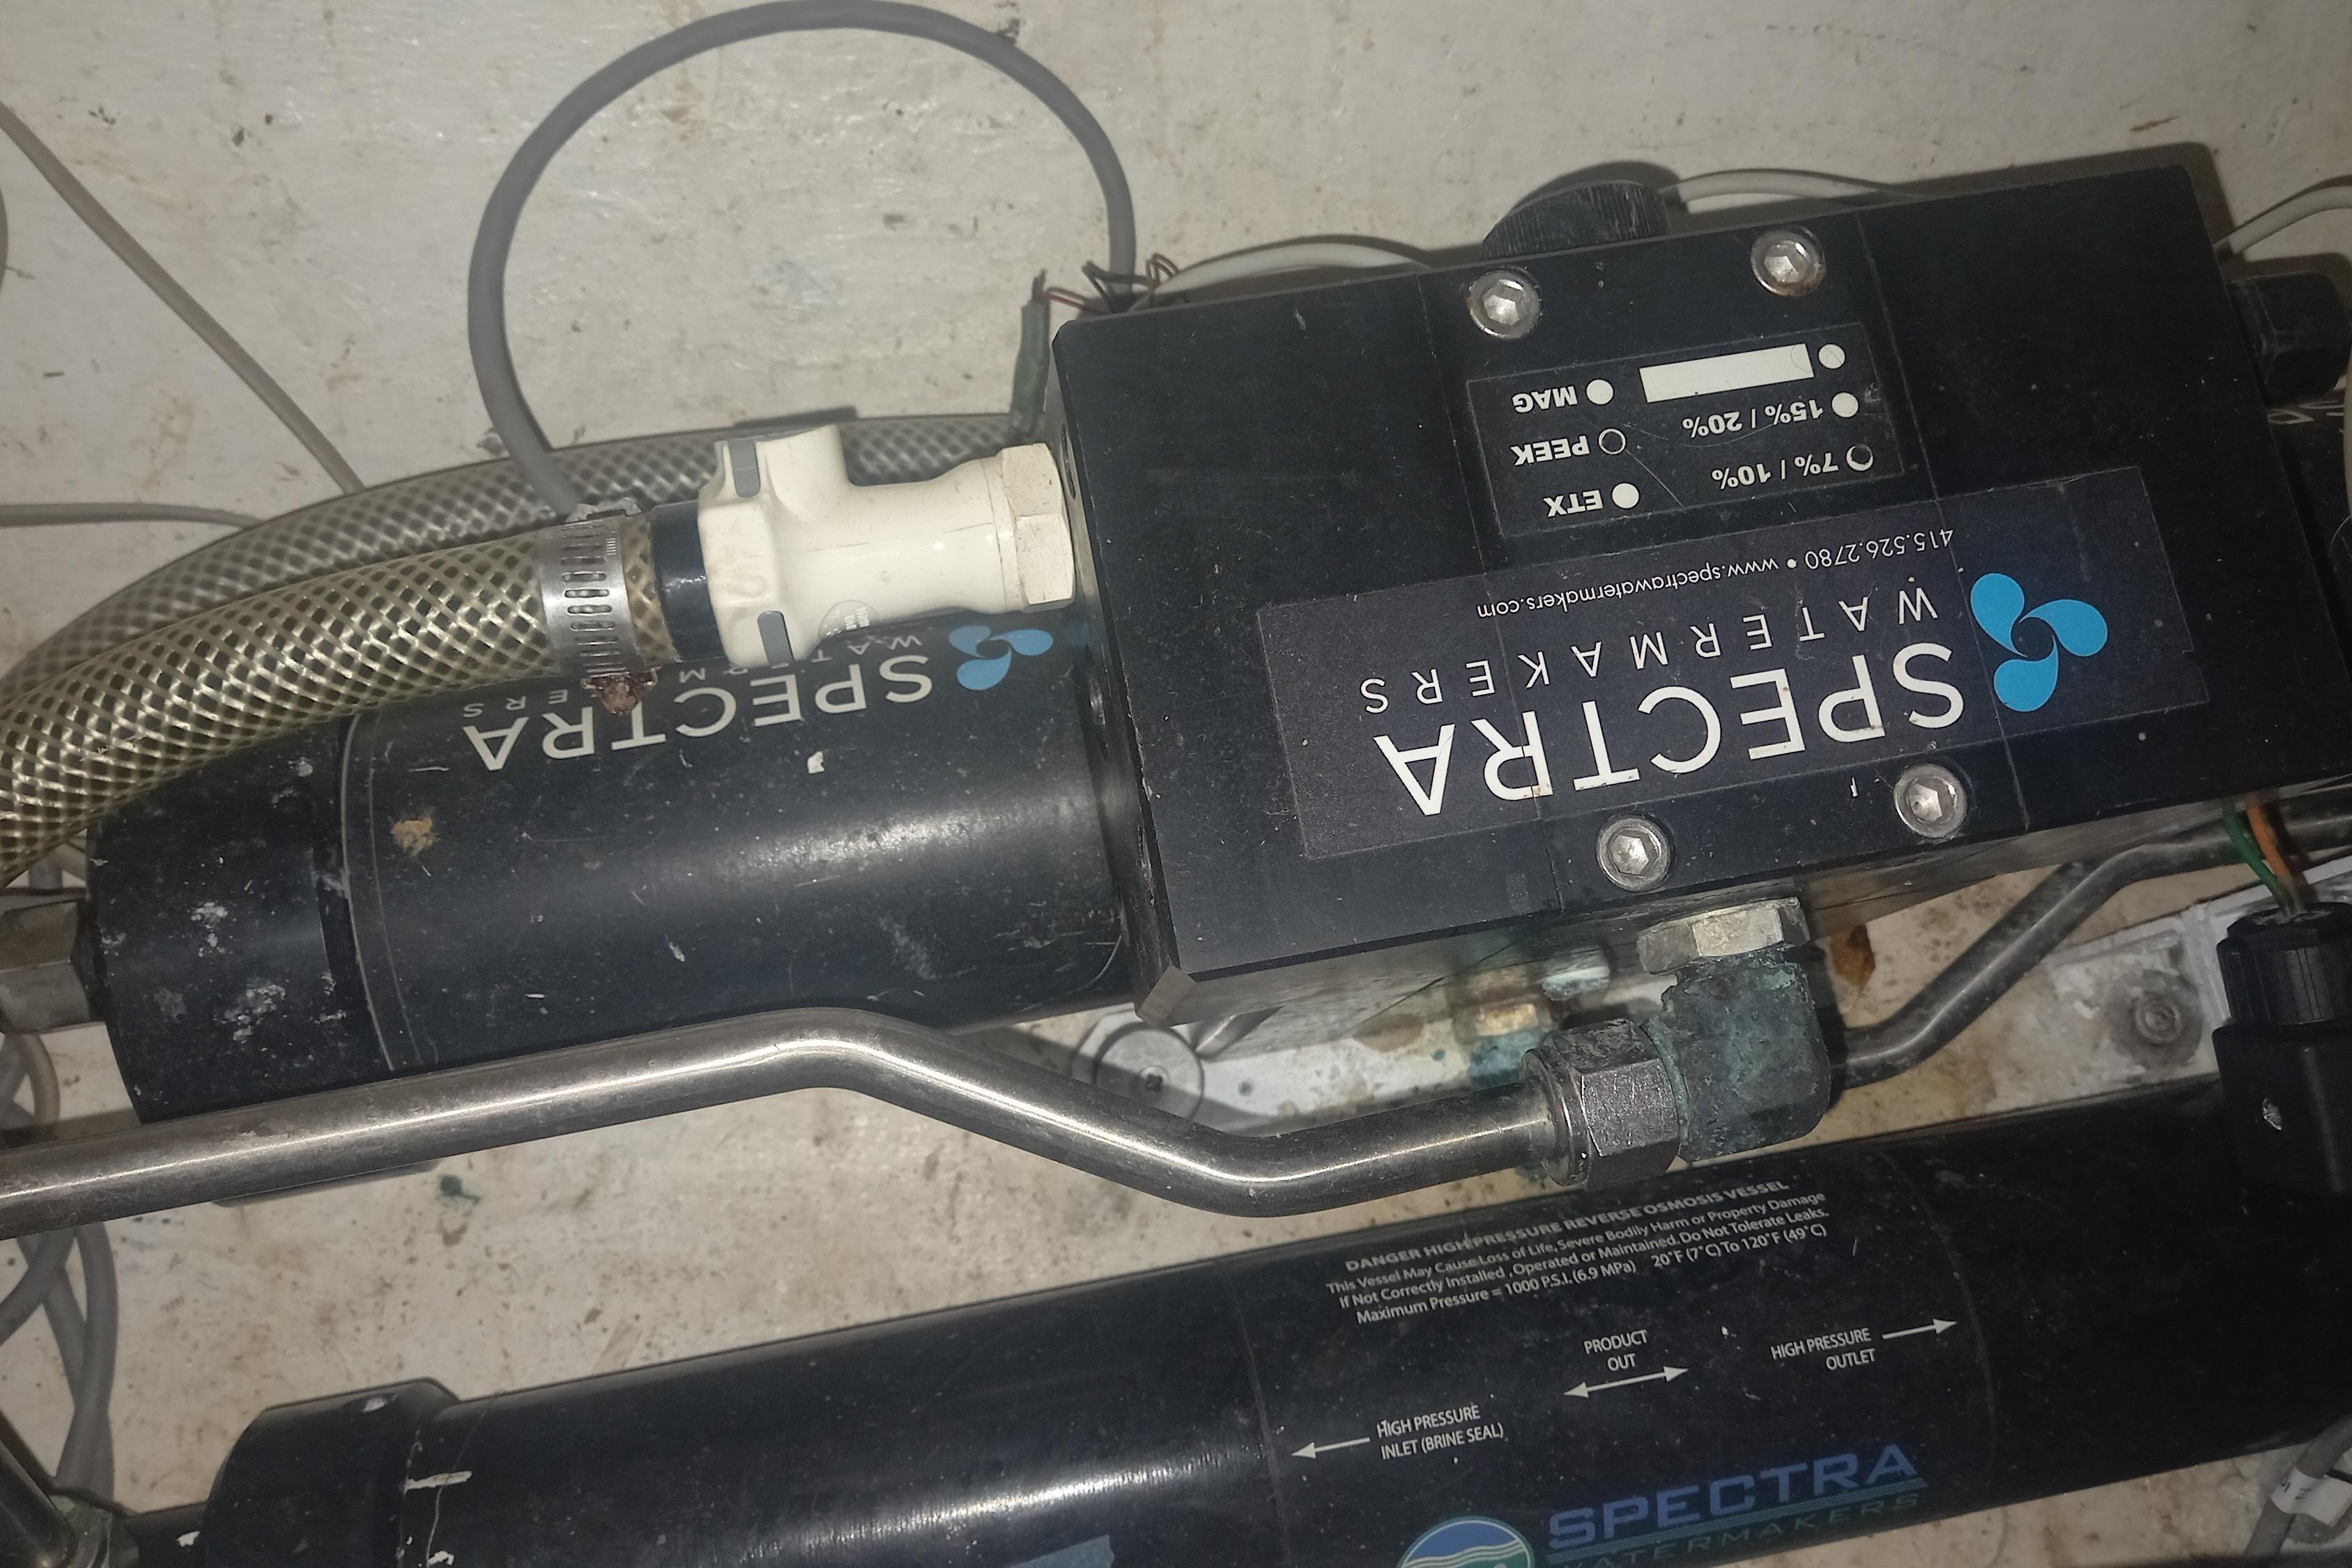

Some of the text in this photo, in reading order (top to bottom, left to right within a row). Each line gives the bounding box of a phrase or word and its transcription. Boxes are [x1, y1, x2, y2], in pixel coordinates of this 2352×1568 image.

[1512, 385, 1578, 413] MAG
[1682, 399, 1824, 438] 15% / 20%
[1510, 436, 1590, 466] PEEK
[1712, 453, 1840, 490] 7% / 10%
[1543, 490, 1603, 518] ETX
[1477, 529, 1953, 619] 415.526.2780 www.spectrawatermakers.com
[1361, 587, 1939, 714] WATERMAKERS
[463, 655, 932, 771] SPECTRA
[1373, 642, 1964, 817] SPECTRA
[1325, 1280, 1356, 1294] This
[1357, 1270, 1401, 1289] Vessel
[1404, 1266, 1432, 1282] May
[1435, 1259, 1477, 1274] Cause
[1478, 1251, 1509, 1266] Loss
[1512, 1247, 1526, 1259] of
[1605, 1224, 1649, 1242] Bodily
[1650, 1217, 1689, 1232] Harm
[1691, 1213, 1706, 1224] or
[1707, 1204, 1767, 1223] Property
[1767, 1192, 1826, 1211] Damage
[1345, 1181, 1790, 1272] DANGER HIGH PRESSURE REVERSE OSMOSIS VESSEL
[1339, 1296, 1352, 1309] If
[1353, 1291, 1380, 1307] Not
[1381, 1278, 1444, 1300] Correctly
[1446, 1267, 1505, 1288] Installed
[1581, 1252, 1596, 1263] or
[1702, 1224, 1730, 1239] Not
[1731, 1214, 1785, 1233] Tolerate
[1785, 1207, 1829, 1224] Leaks.
[1356, 1301, 1427, 1324] Maximum
[1429, 1289, 1489, 1311] Pressure
[1492, 1288, 1502, 1297] =
[1505, 1278, 1539, 1296] 1000
[1601, 1260, 1637, 1279] MPa)
[1723, 1240, 1740, 1254] To
[1583, 1330, 1648, 1355] PRODUCT
[1770, 1328, 1872, 1360] HIGH PRESSURE
[1825, 1348, 1876, 1371] OUTLET
[1607, 1353, 1637, 1373] OUT
[1376, 1404, 1481, 1438] HIGH PRESSURE
[1381, 1422, 1505, 1461] INLET (BRINE SEAL)
[1548, 1443, 1919, 1550] SPECTRA
[1561, 1493, 1920, 1568] ATERMAKERS
